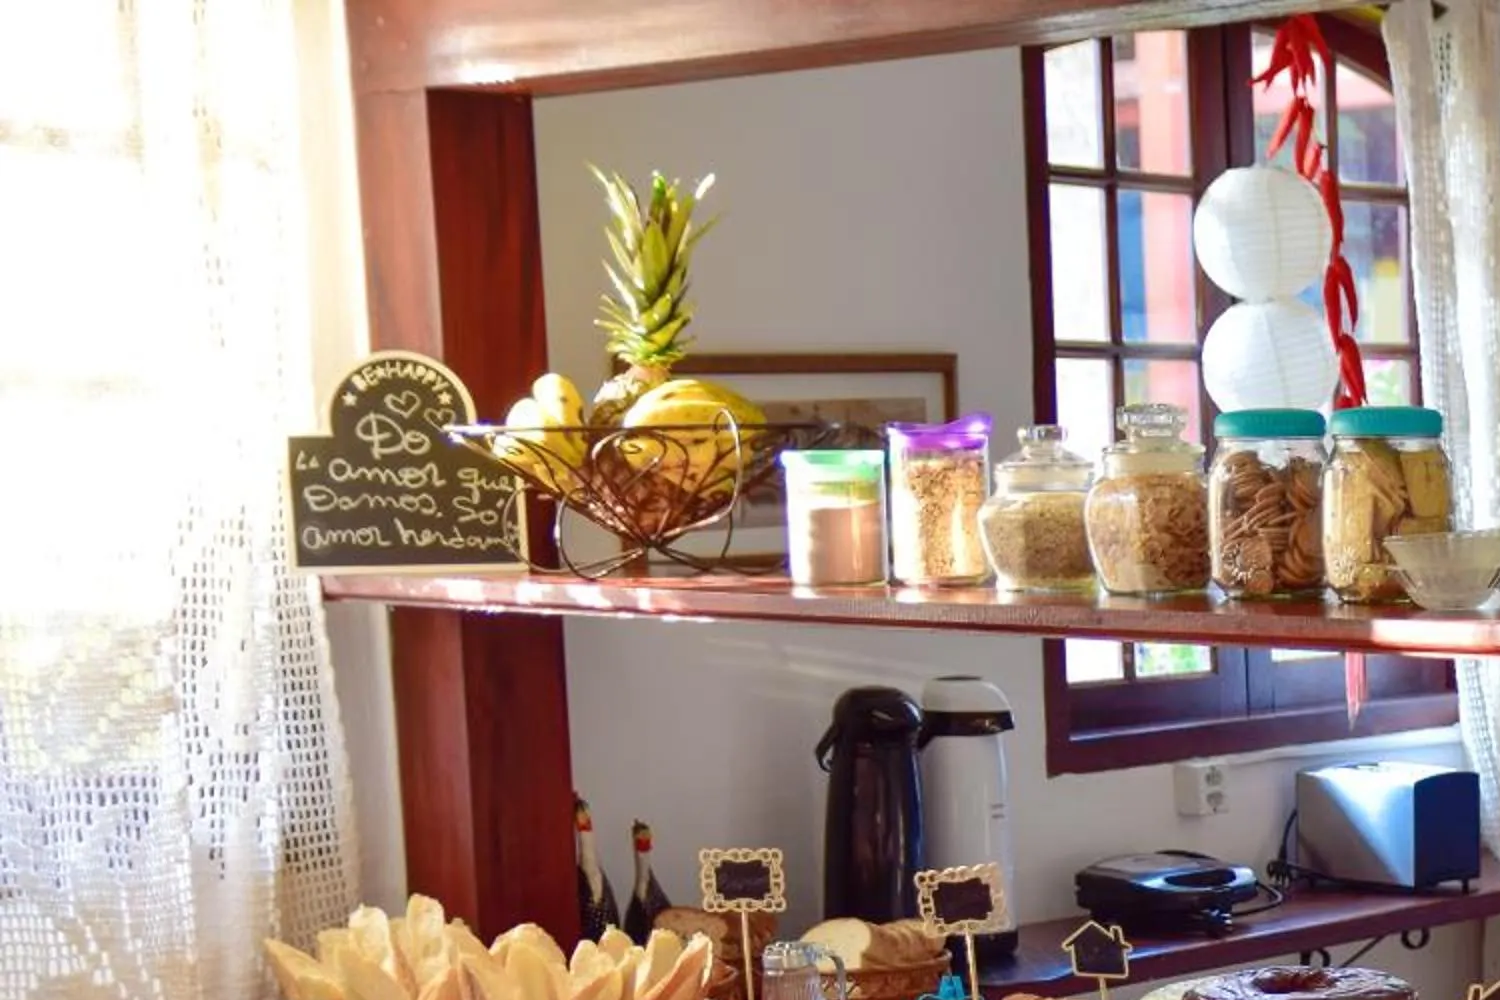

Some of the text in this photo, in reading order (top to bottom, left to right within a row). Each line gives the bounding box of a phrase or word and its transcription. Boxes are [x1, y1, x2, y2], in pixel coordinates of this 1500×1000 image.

[385, 361, 451, 392] HAPPY
[355, 411, 432, 460] Do
[456, 467, 514, 505] que
[303, 524, 392, 550] amor
